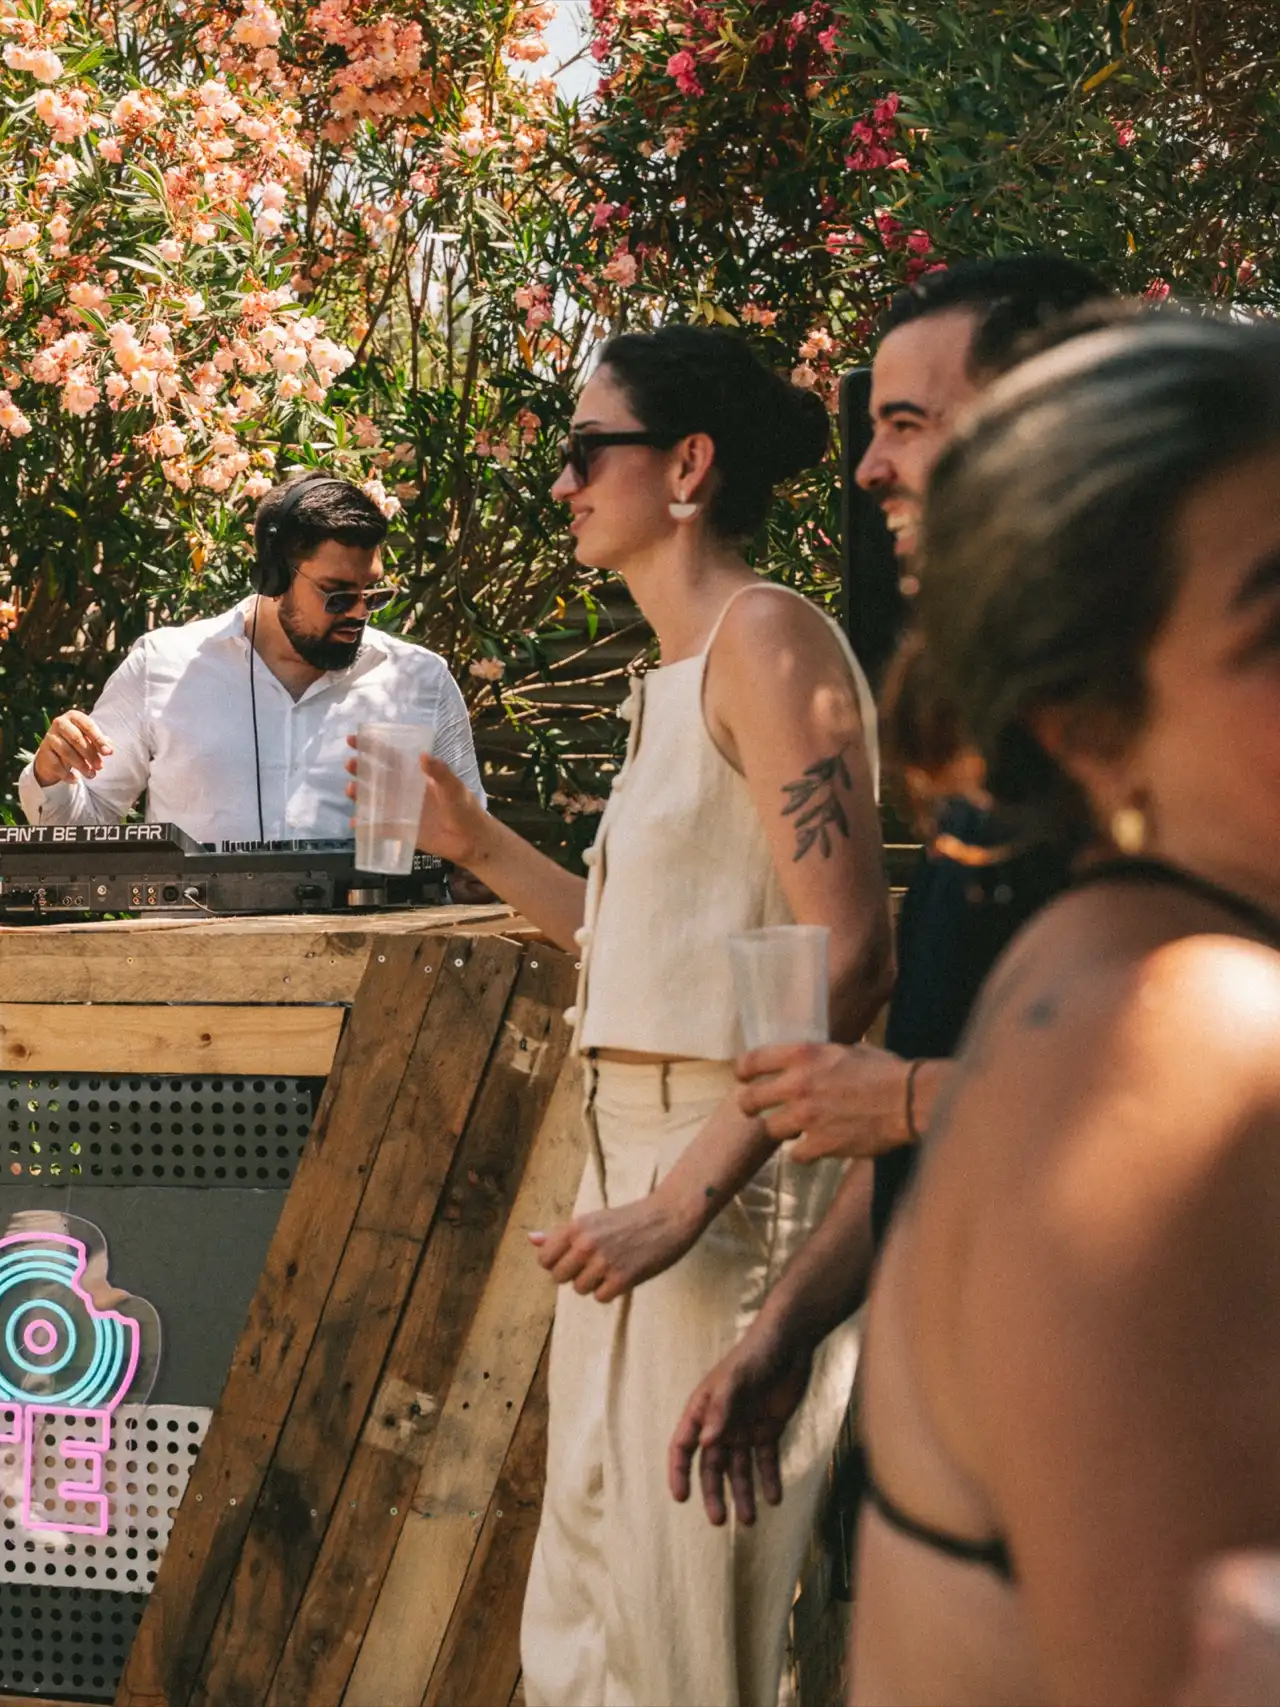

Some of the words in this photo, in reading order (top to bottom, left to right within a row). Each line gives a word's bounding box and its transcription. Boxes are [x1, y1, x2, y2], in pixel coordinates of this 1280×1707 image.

[52, 826, 77, 842] BE
[83, 826, 120, 841] TOO
[125, 825, 163, 841] FAR
